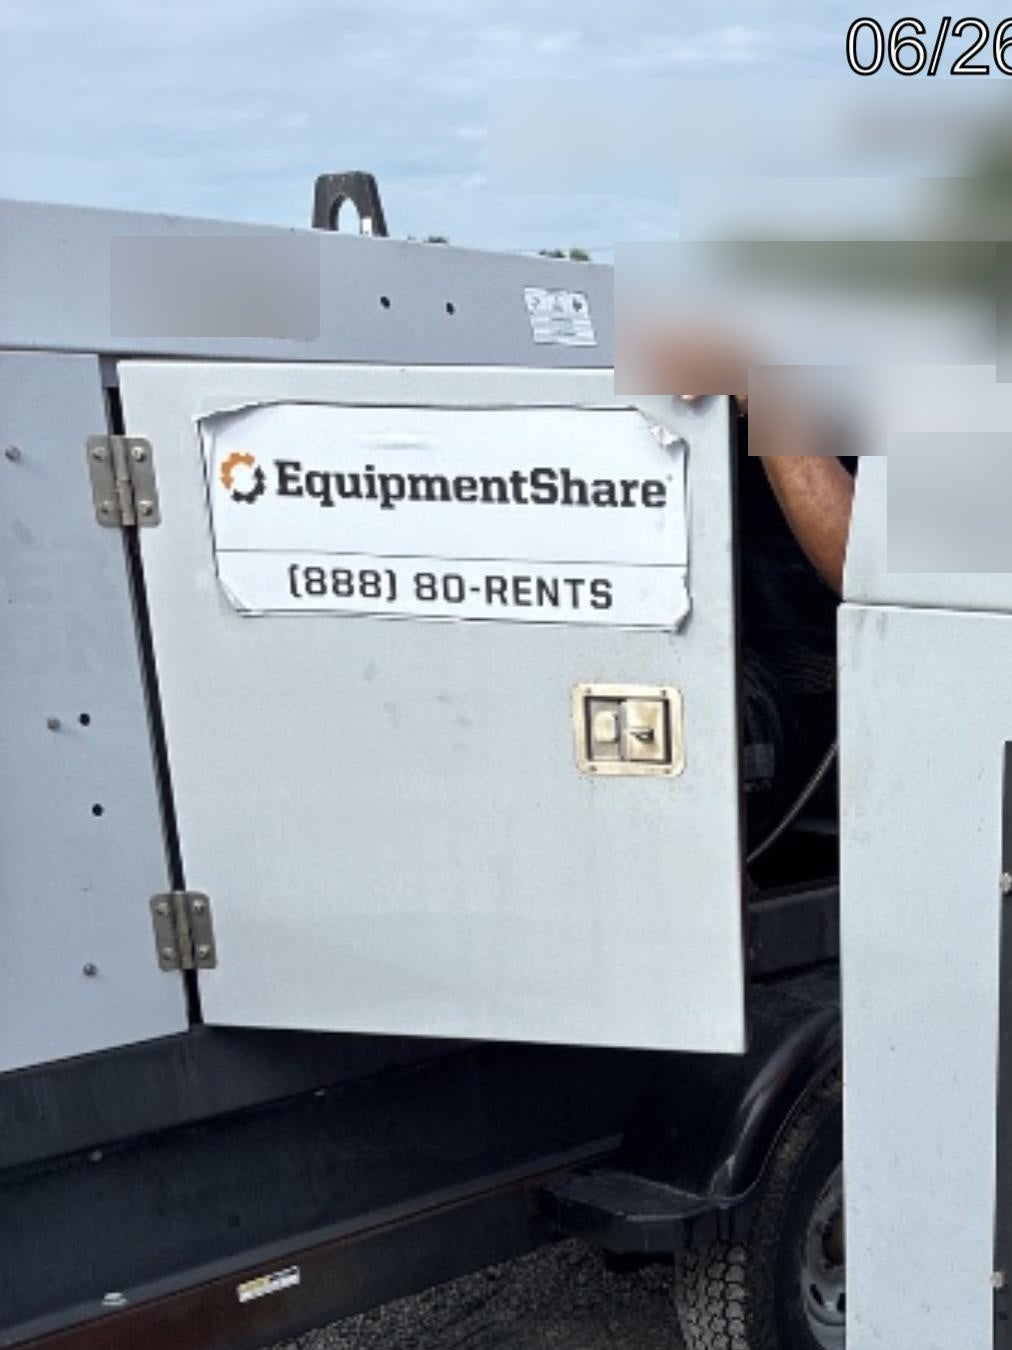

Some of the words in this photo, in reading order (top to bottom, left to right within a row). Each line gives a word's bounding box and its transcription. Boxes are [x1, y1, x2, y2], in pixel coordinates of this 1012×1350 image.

[274, 459, 666, 510] EquipmentShare
[289, 563, 397, 602] (888)
[413, 572, 613, 610] 80-RENTS
